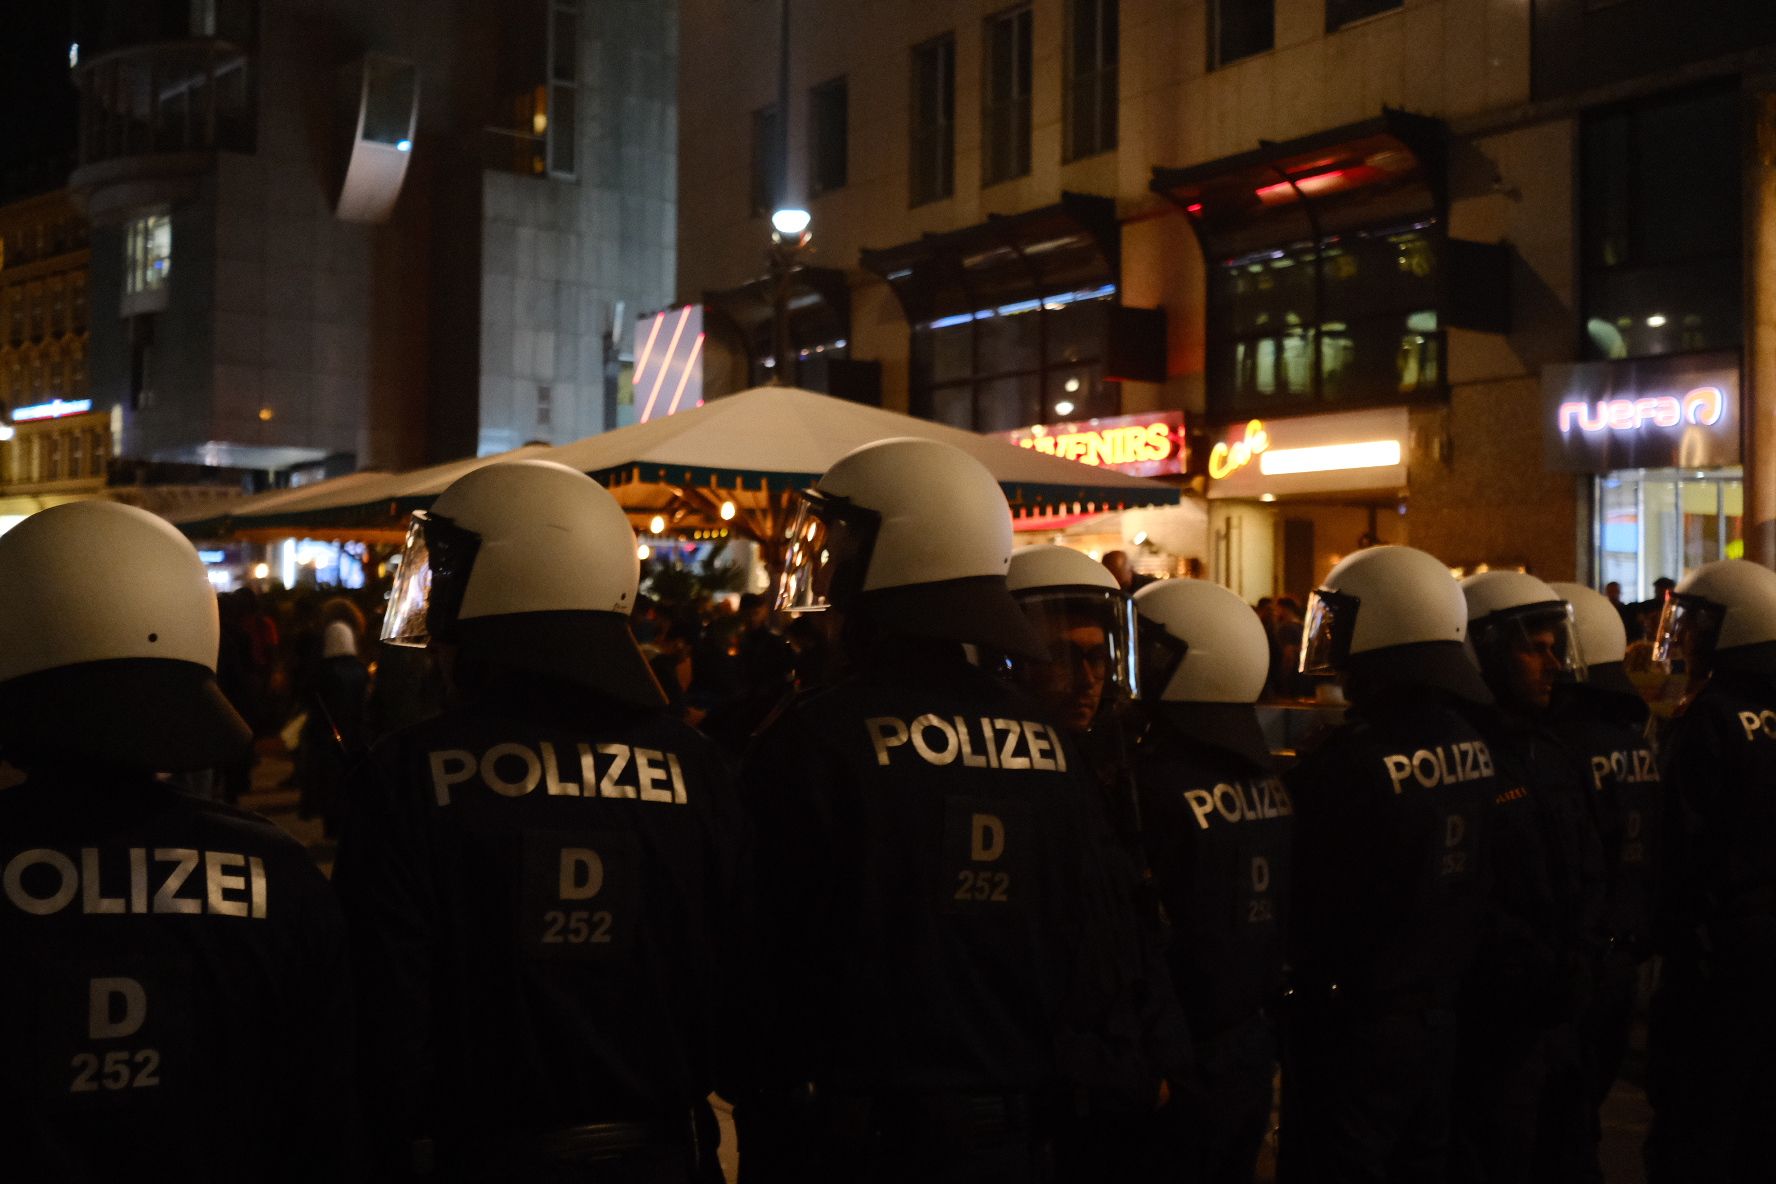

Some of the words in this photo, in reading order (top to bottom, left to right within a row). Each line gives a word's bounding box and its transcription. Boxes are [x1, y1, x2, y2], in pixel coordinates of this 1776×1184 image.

[1559, 396, 1680, 432] ruefa
[864, 712, 1068, 773] POLIZEI
[428, 741, 688, 807] POLIZEI
[971, 812, 1006, 862] D
[559, 848, 604, 900] D
[953, 869, 1009, 902] 252
[542, 910, 613, 943] 252
[89, 976, 147, 1040] D
[70, 1049, 161, 1093] 252
